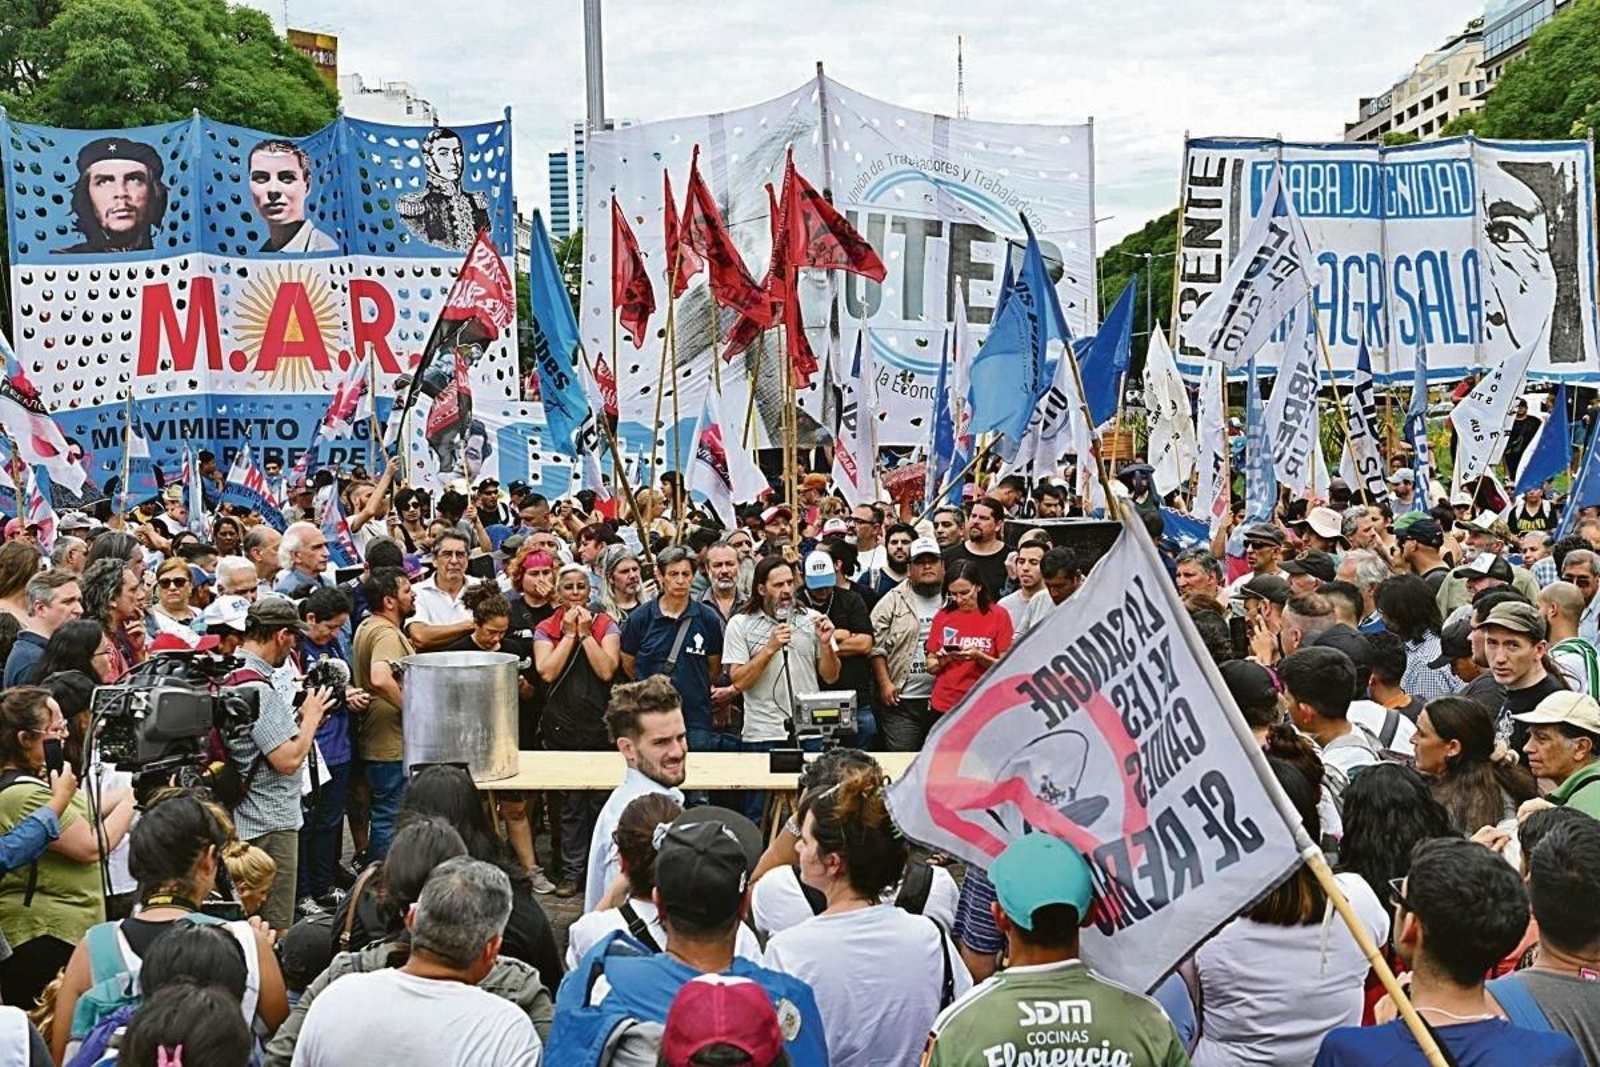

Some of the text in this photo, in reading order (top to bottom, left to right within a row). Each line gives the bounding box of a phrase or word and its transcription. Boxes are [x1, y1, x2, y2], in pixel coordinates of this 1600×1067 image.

[871, 159, 885, 176] de
[961, 167, 970, 181] y
[973, 169, 1048, 234] Trabajadoras
[1394, 249, 1484, 345] SALA
[838, 450, 857, 475] CABA
[953, 637, 992, 649] LIBRES
[1017, 1000, 1092, 1026] SDM
[1026, 1030, 1089, 1045] COCINAS
